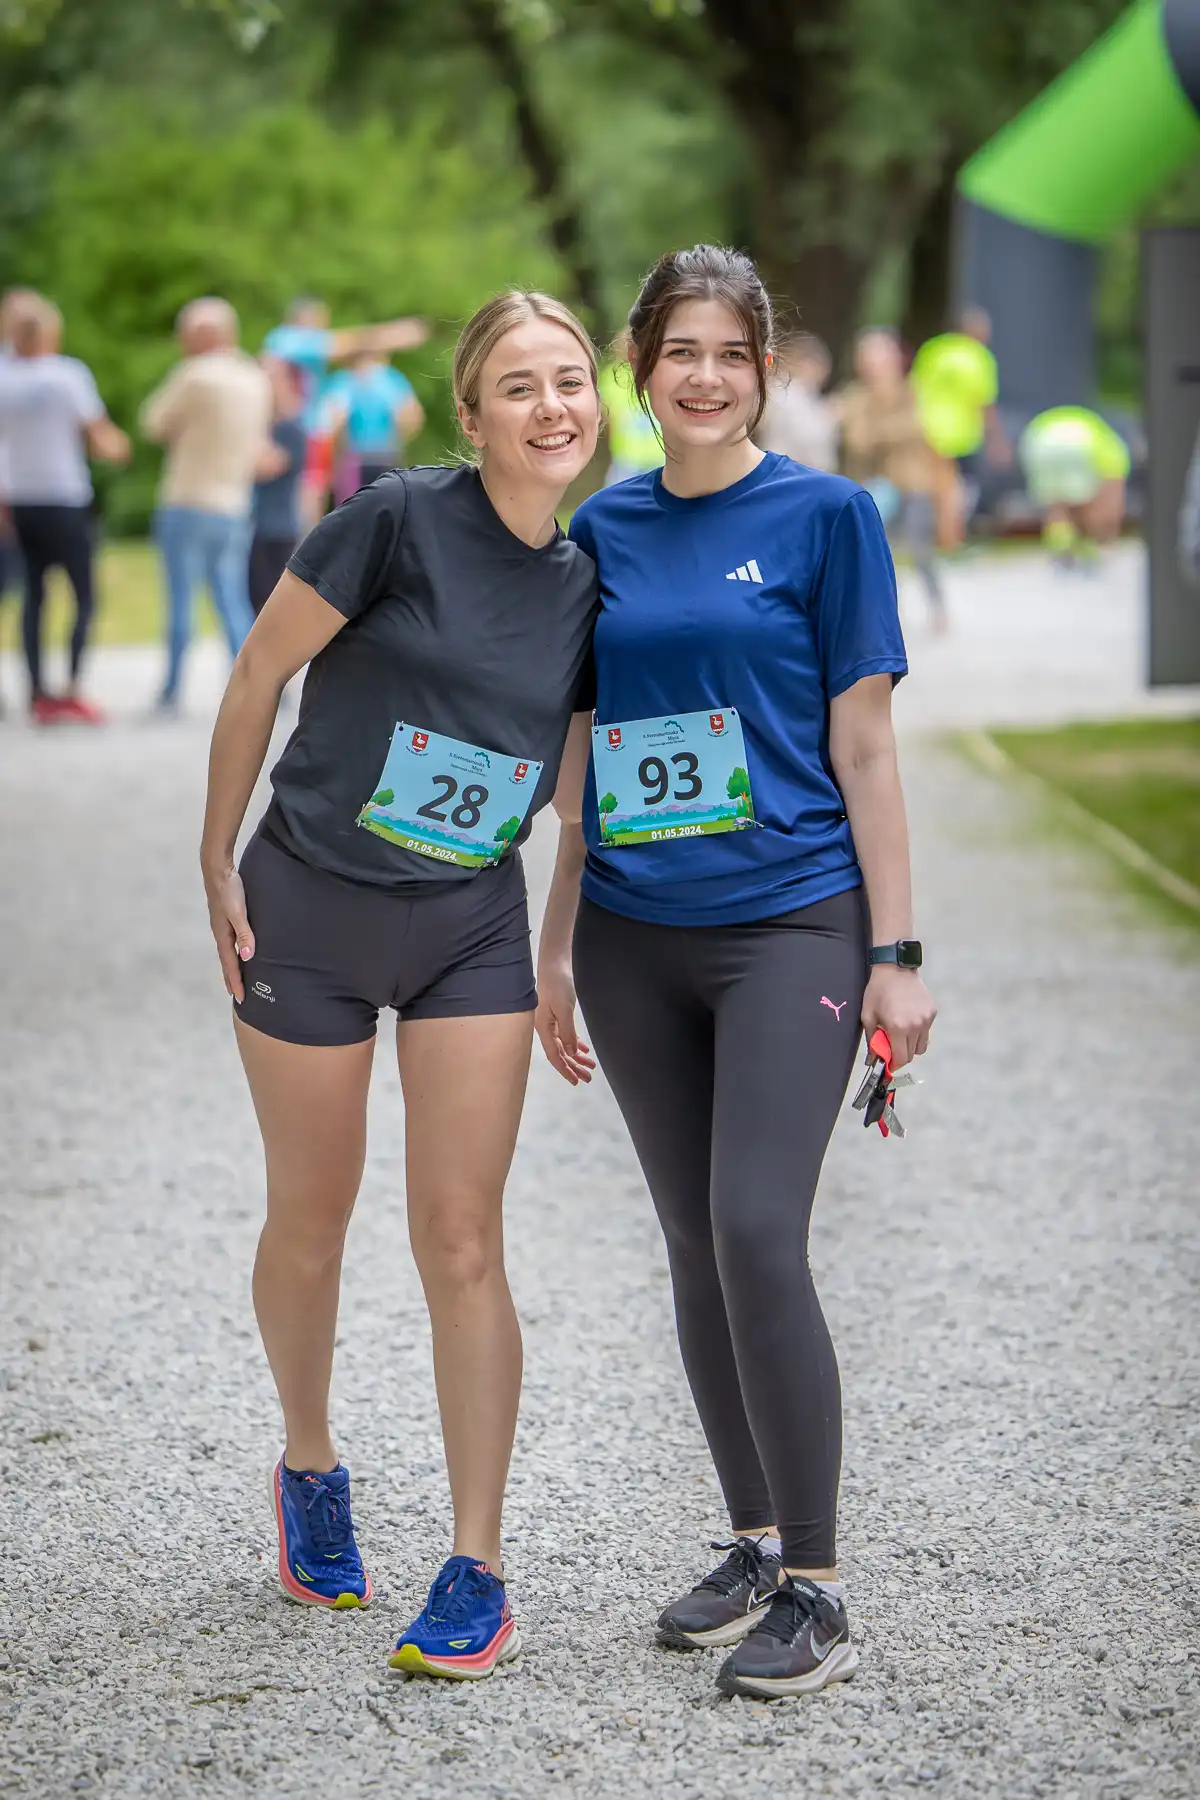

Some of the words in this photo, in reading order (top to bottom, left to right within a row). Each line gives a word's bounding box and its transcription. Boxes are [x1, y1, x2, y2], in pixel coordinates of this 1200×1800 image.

[638, 752, 703, 806] 93
[416, 774, 489, 829] 28
[406, 838, 458, 862] 01.05.2024.
[651, 825, 705, 840] 01.05.2024.
